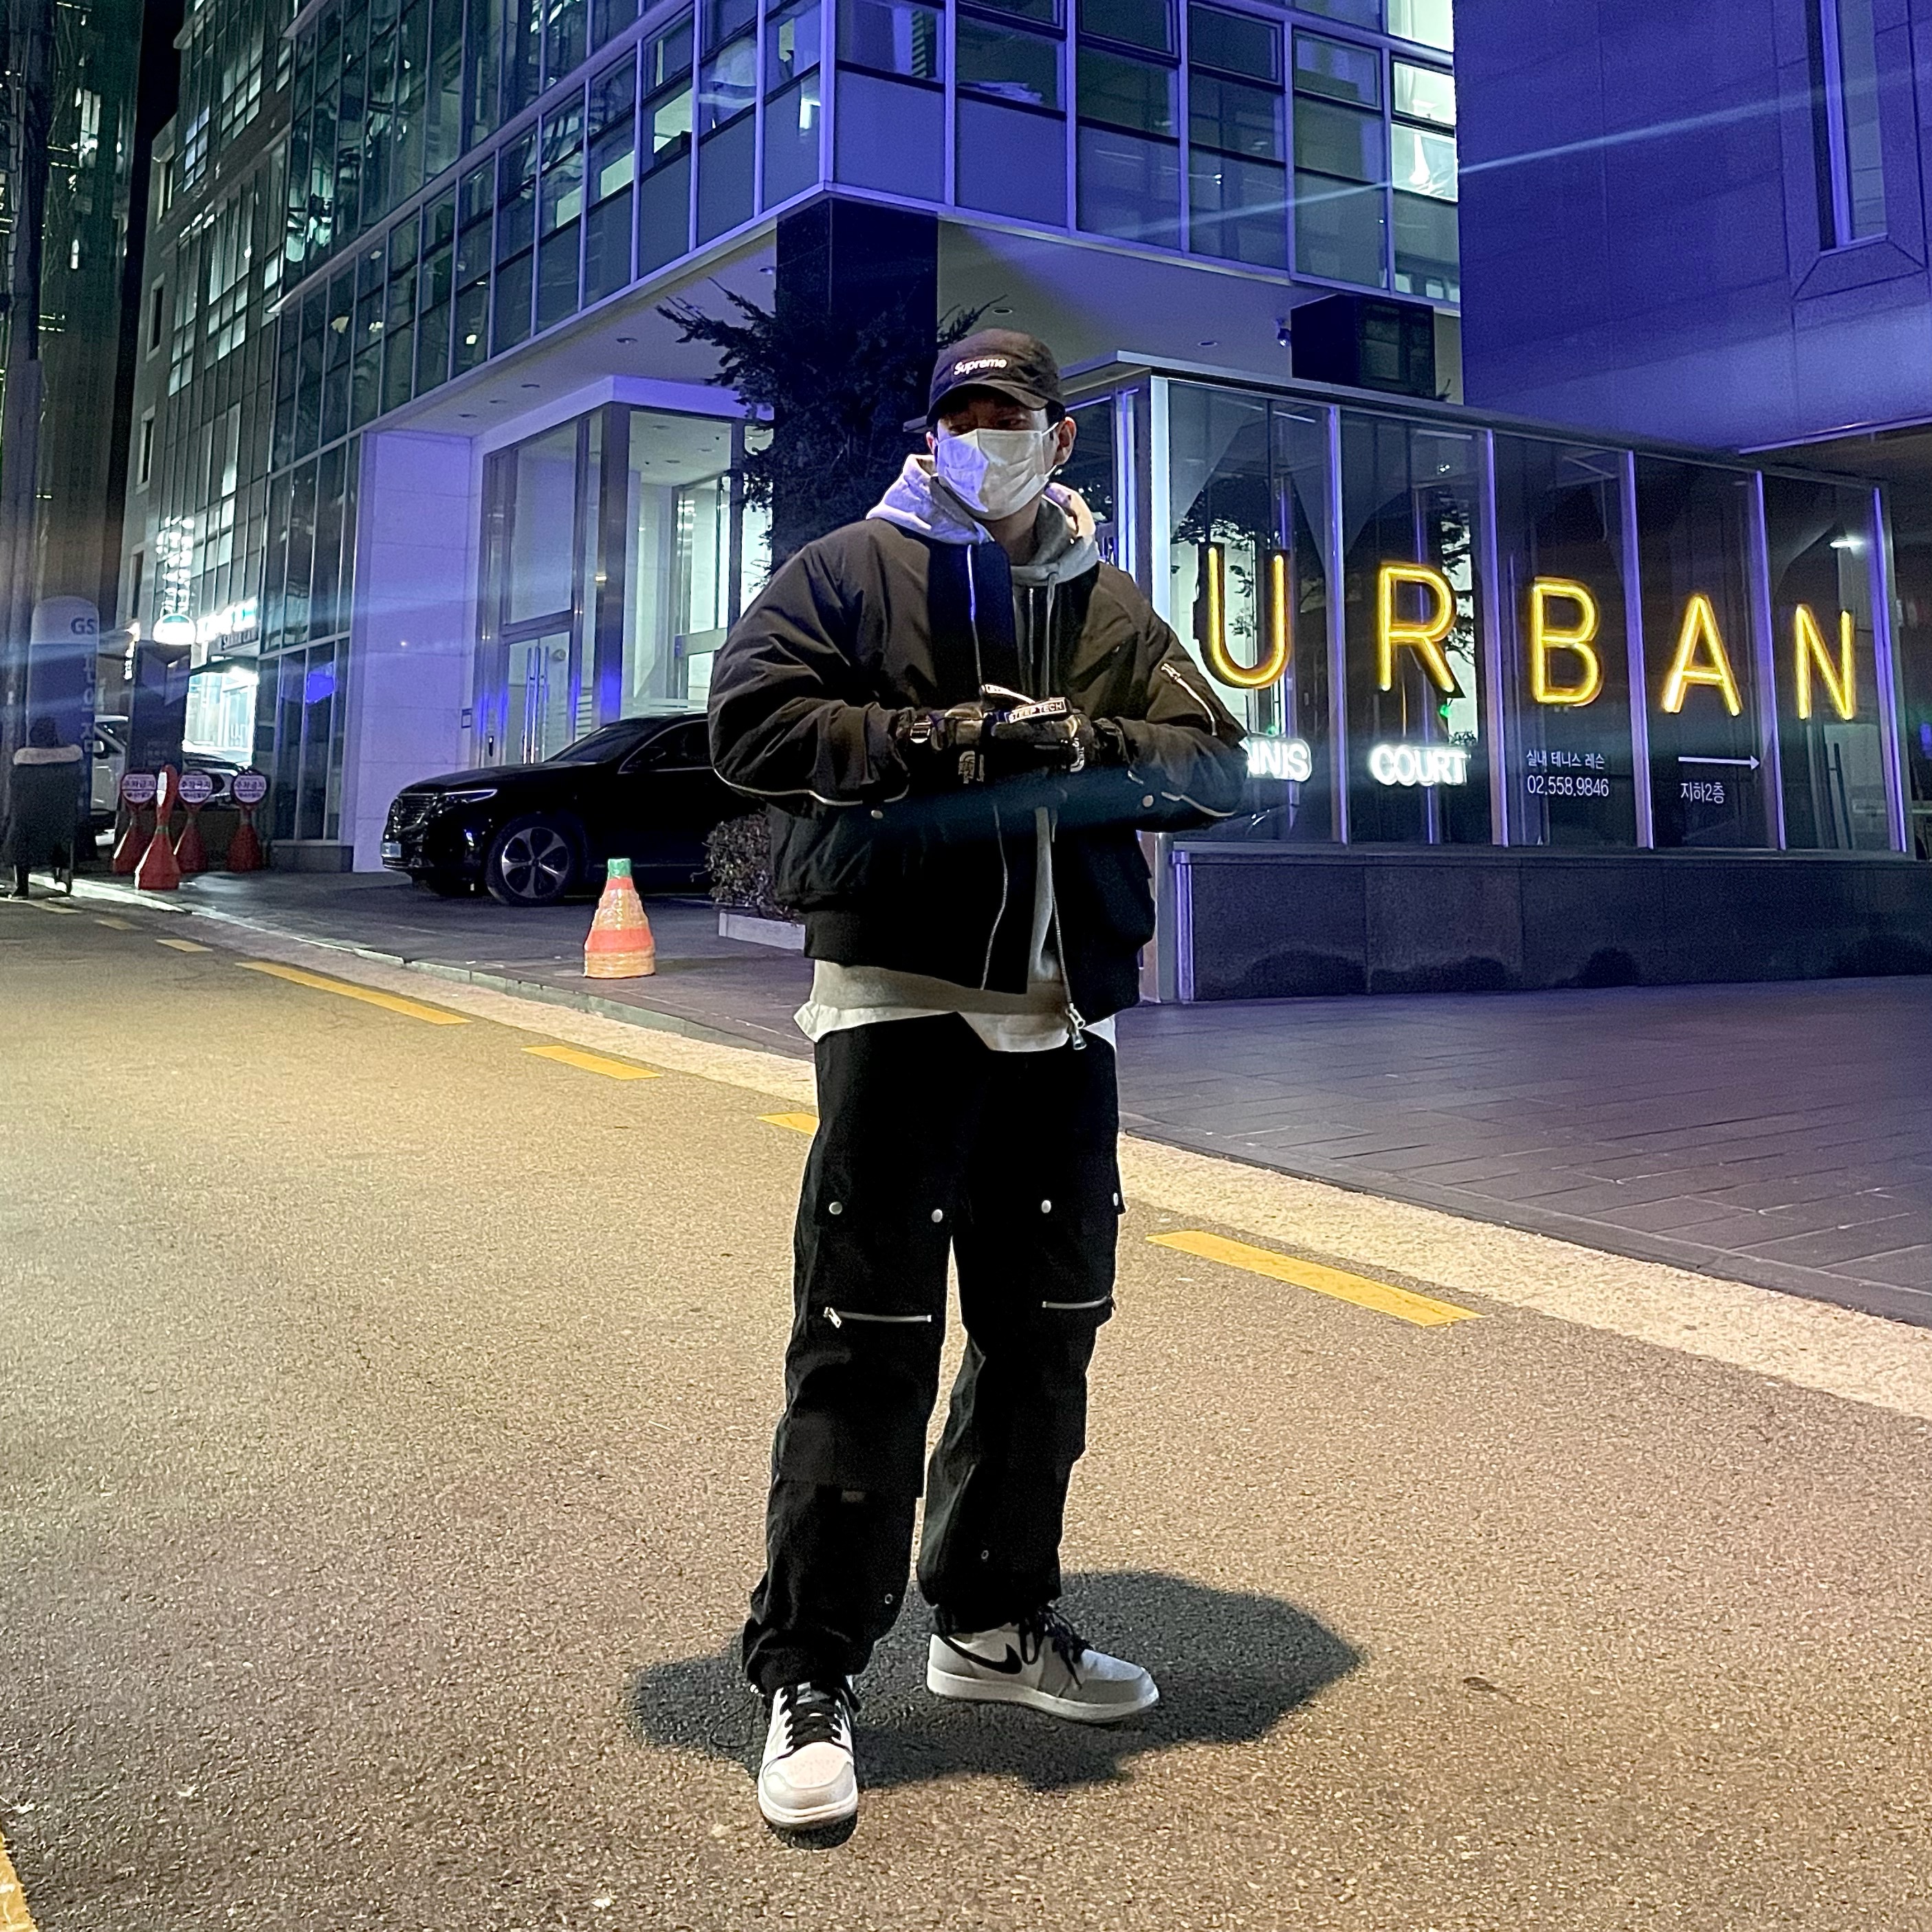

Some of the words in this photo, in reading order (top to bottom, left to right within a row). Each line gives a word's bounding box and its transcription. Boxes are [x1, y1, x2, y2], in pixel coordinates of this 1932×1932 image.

[954, 359, 1007, 375] Supreme
[1206, 545, 1855, 720] URBAN
[1039, 702, 1063, 714] TECH
[1371, 745, 1467, 785] COURT
[1526, 749, 1548, 767] 실내
[1551, 751, 1583, 768] 테니스
[1585, 753, 1605, 770] 레슨
[1527, 774, 1609, 797] 02.558.9846
[1680, 781, 1726, 804] 지하2층
